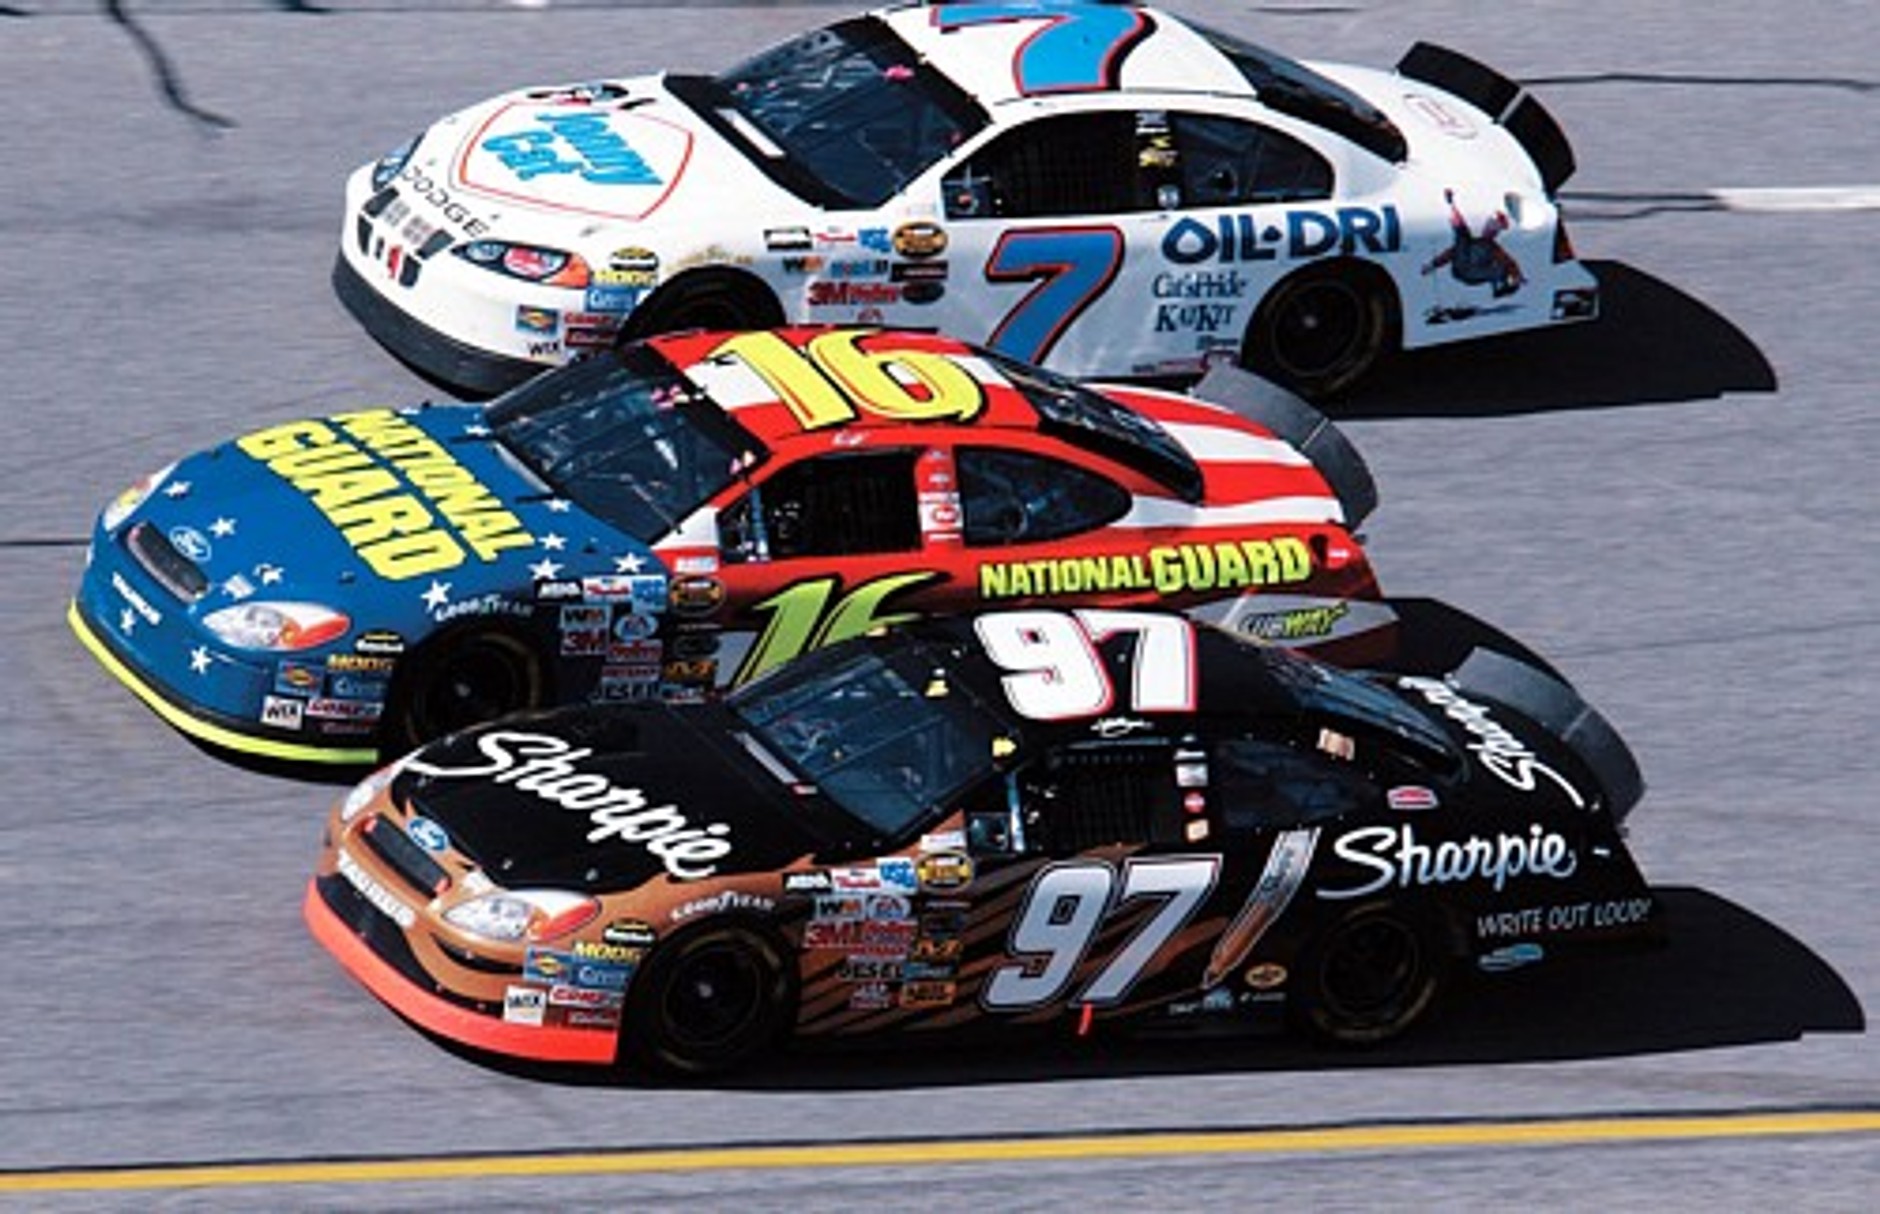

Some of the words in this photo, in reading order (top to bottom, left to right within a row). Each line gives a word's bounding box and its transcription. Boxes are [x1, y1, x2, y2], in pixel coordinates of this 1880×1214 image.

[930, 3, 1143, 95] 7
[402, 166, 490, 238] DODGE
[985, 226, 1125, 365] 7
[708, 330, 986, 430] 16
[236, 419, 468, 581] GUARD
[327, 409, 536, 562] NATIONAL
[980, 554, 1150, 598] NATIONAL
[1149, 535, 1312, 594] GUARD
[973, 608, 1197, 723] 97
[401, 731, 733, 879] Sharpie
[1315, 824, 1577, 899] Sharpie
[981, 853, 1224, 1012] 97
[1477, 907, 1544, 938] WRITE
[1549, 903, 1592, 931] OUT
